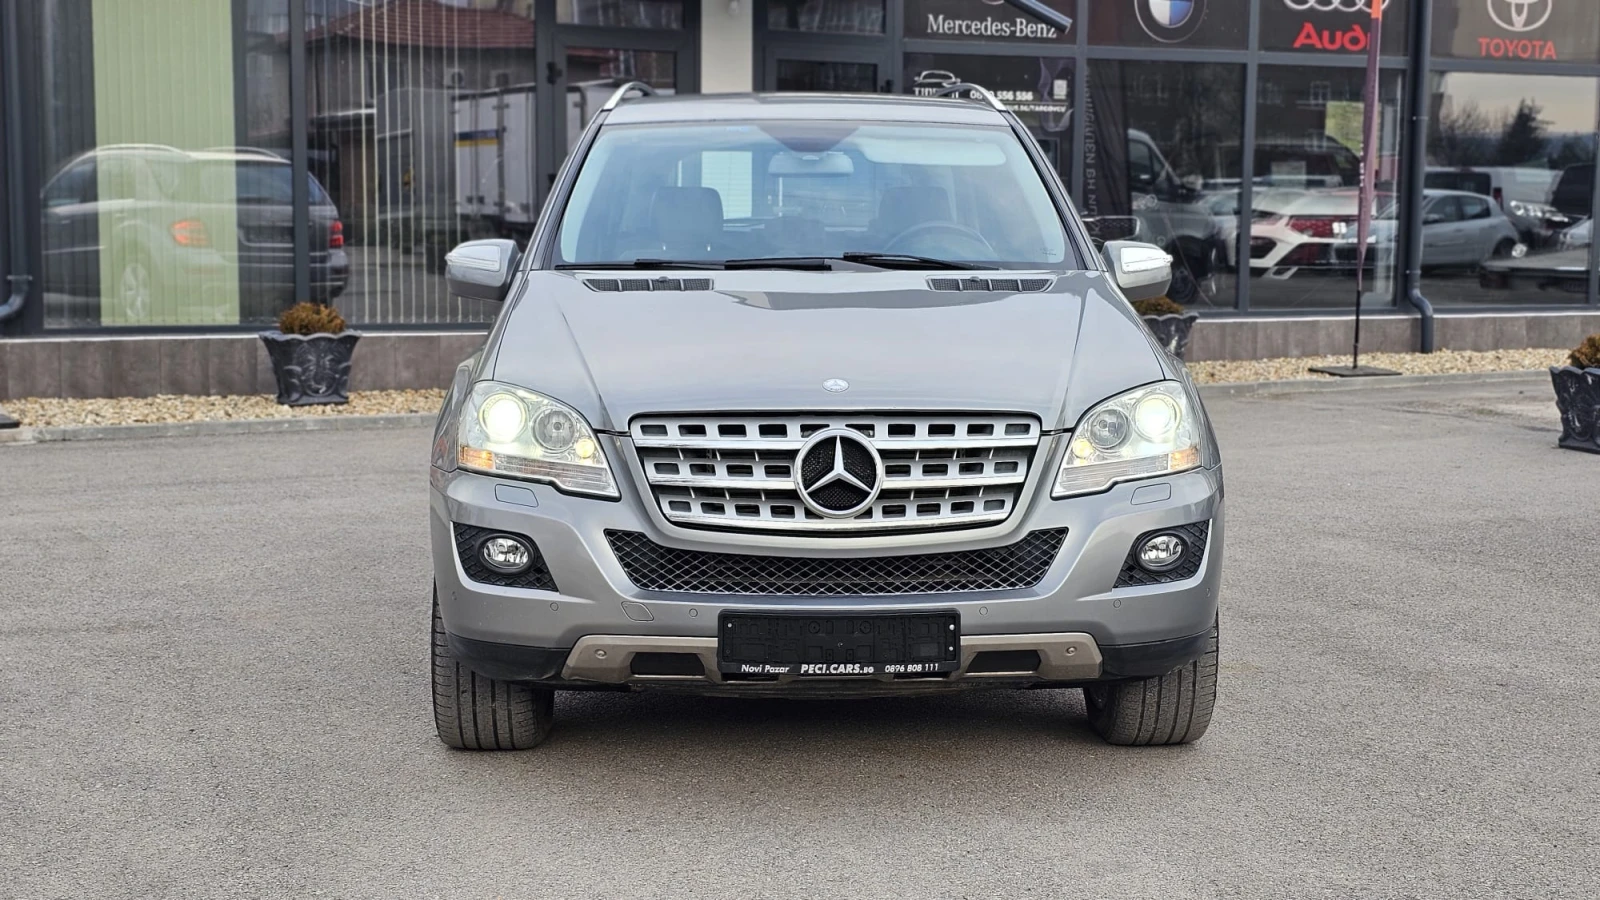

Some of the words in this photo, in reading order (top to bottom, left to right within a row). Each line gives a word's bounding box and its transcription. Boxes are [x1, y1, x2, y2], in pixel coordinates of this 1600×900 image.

[927, 14, 1057, 38] Mercedes-Benz
[1478, 37, 1557, 60] TOYOTA
[741, 664, 763, 673] Novi
[764, 665, 790, 673] Pazar
[885, 664, 905, 673] 0896
[907, 664, 922, 672] 808
[924, 663, 939, 672] 111
